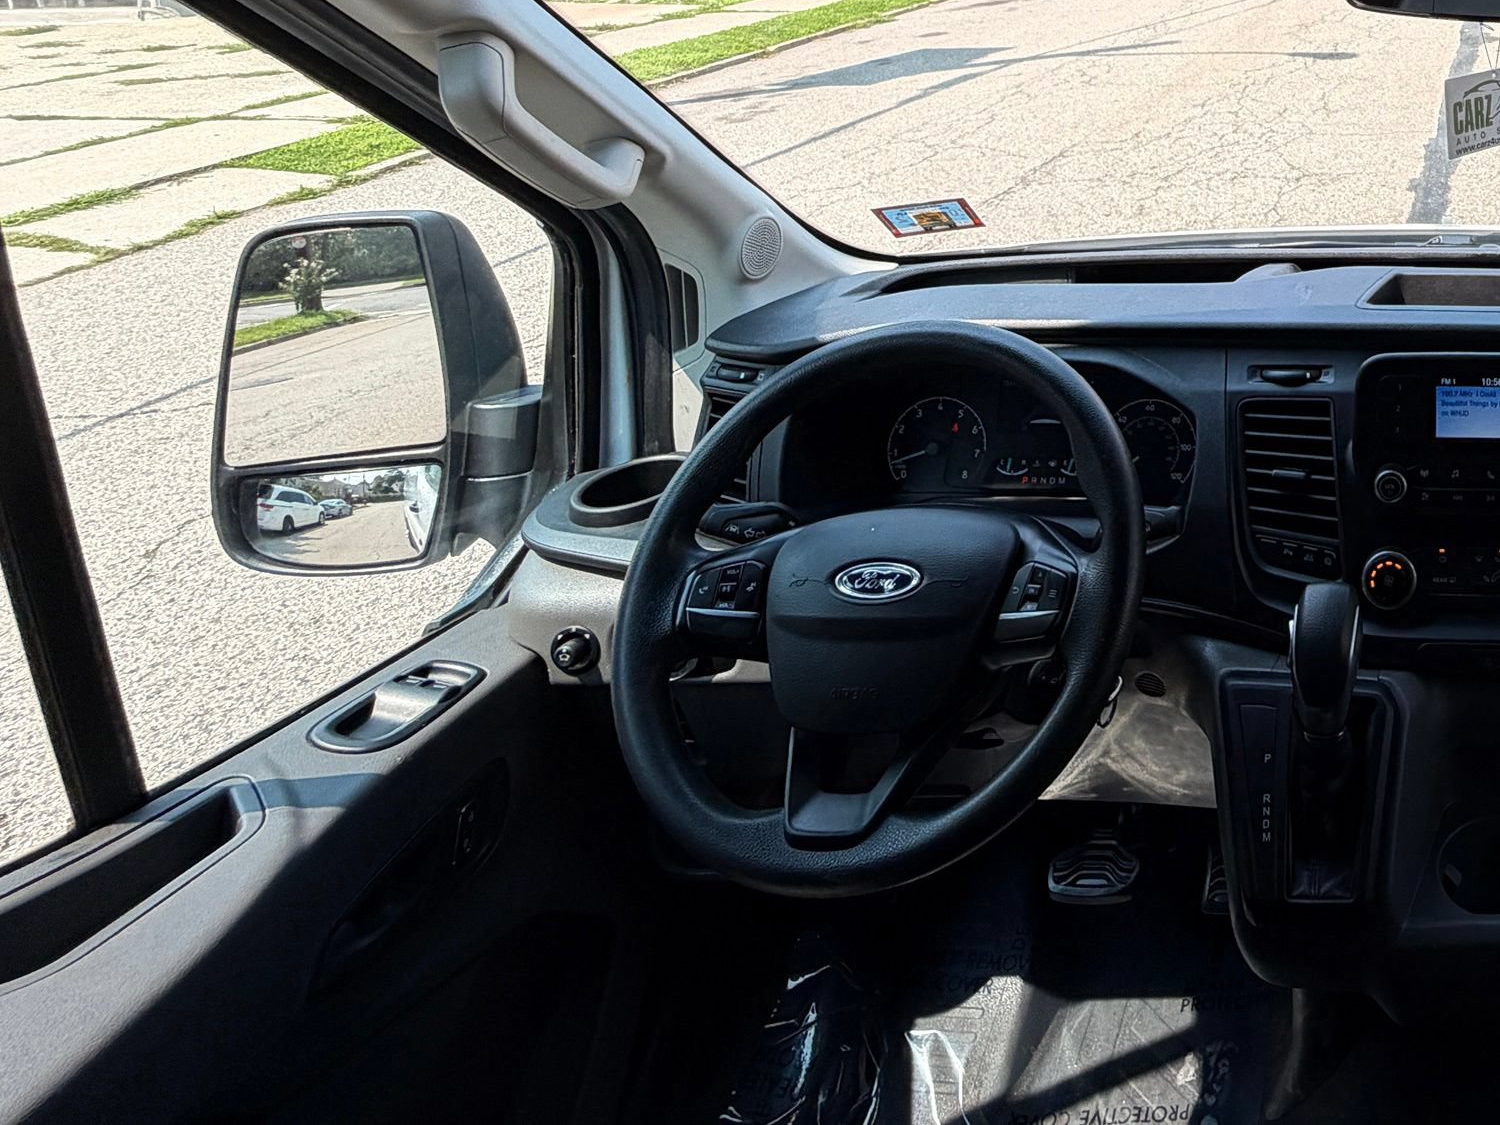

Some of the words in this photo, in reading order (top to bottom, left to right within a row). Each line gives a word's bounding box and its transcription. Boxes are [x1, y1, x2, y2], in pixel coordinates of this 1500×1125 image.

[1453, 93, 1493, 136] CARZ
[1456, 131, 1486, 146] AUTO
[937, 403, 944, 411] 4
[915, 408, 923, 419] 3
[957, 408, 965, 419] 5
[899, 425, 905, 435] 2
[971, 425, 979, 435] 6
[974, 448, 981, 459] 7
[900, 469, 908, 479] 0
[961, 470, 969, 480] 8
[1022, 476, 1029, 484] P
[854, 570, 899, 594] Ford
[1264, 753, 1272, 764] P
[1262, 793, 1271, 804] R
[1262, 806, 1271, 816] N
[1262, 819, 1270, 829] D
[1262, 832, 1271, 843] M
[1080, 1103, 1191, 1125] PROTECTIVE
